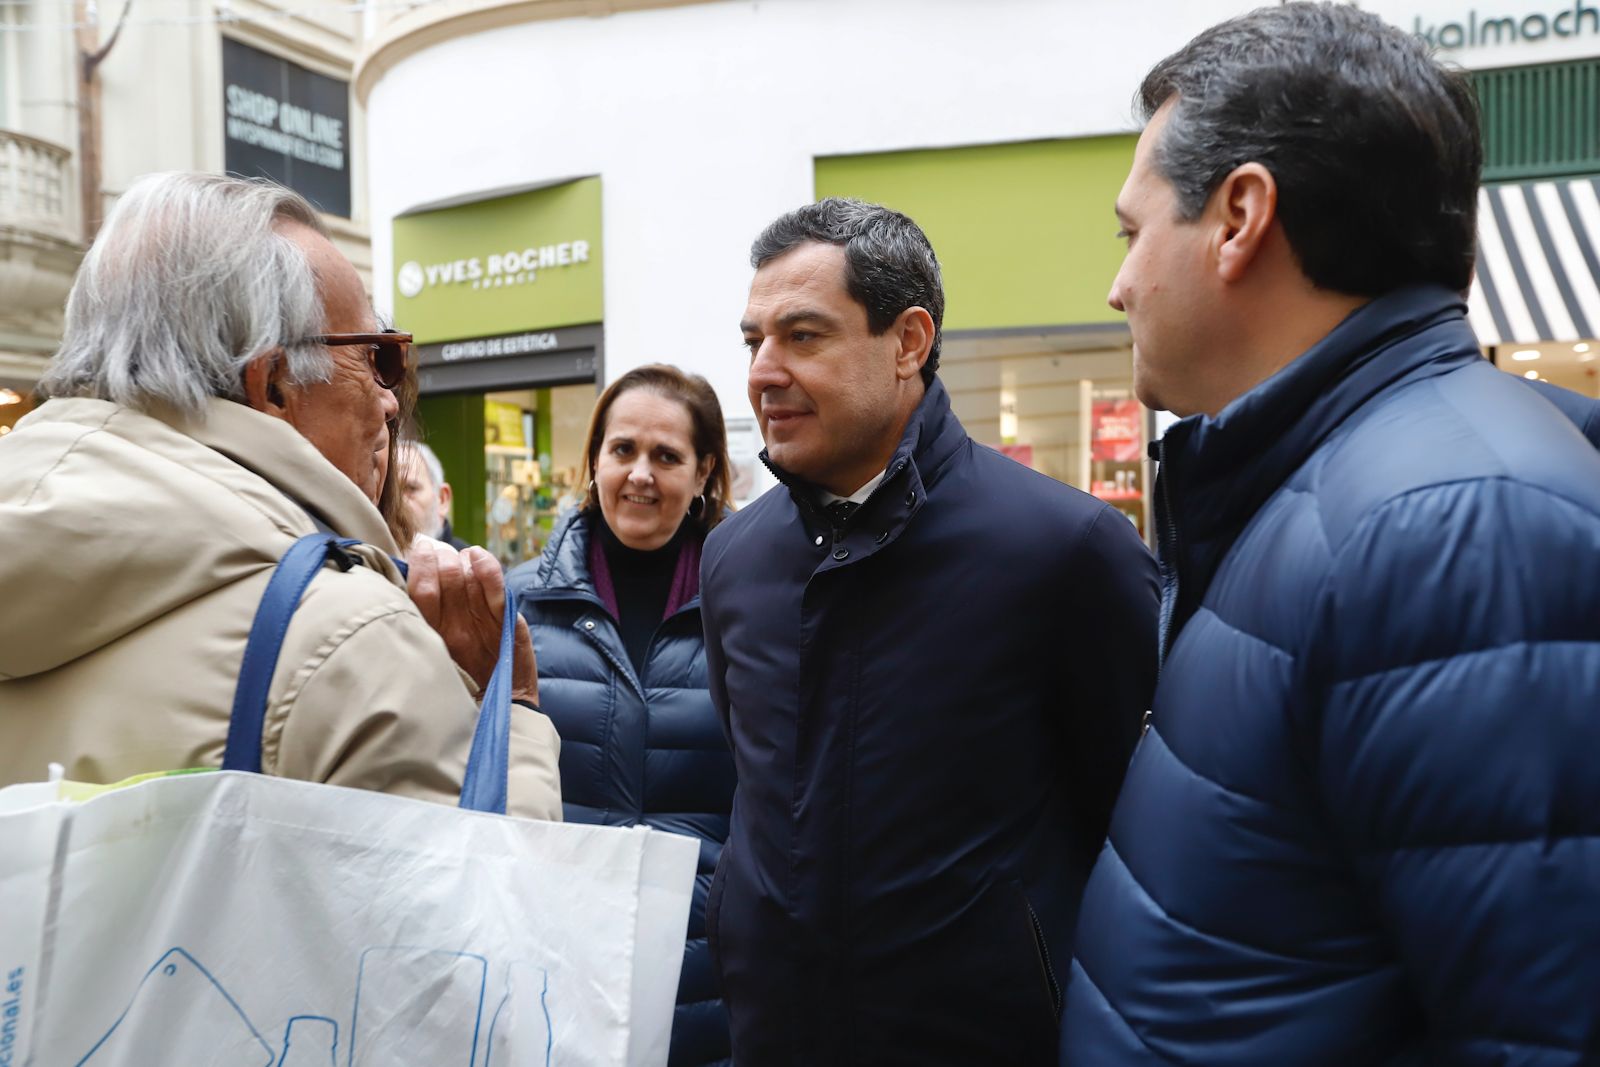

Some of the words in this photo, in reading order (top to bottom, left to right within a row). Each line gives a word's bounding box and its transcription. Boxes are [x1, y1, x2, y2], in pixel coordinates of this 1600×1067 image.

[226, 84, 278, 127] SHOP
[279, 102, 343, 149] ONLINE
[425, 257, 482, 286] YVES
[488, 240, 590, 277] ROCHER
[472, 272, 537, 289] FRANCE
[441, 341, 485, 361] CENTRO
[486, 338, 503, 356] DE
[503, 332, 558, 353] ESTÉTICA
[0, 966, 25, 1067] cional.es
